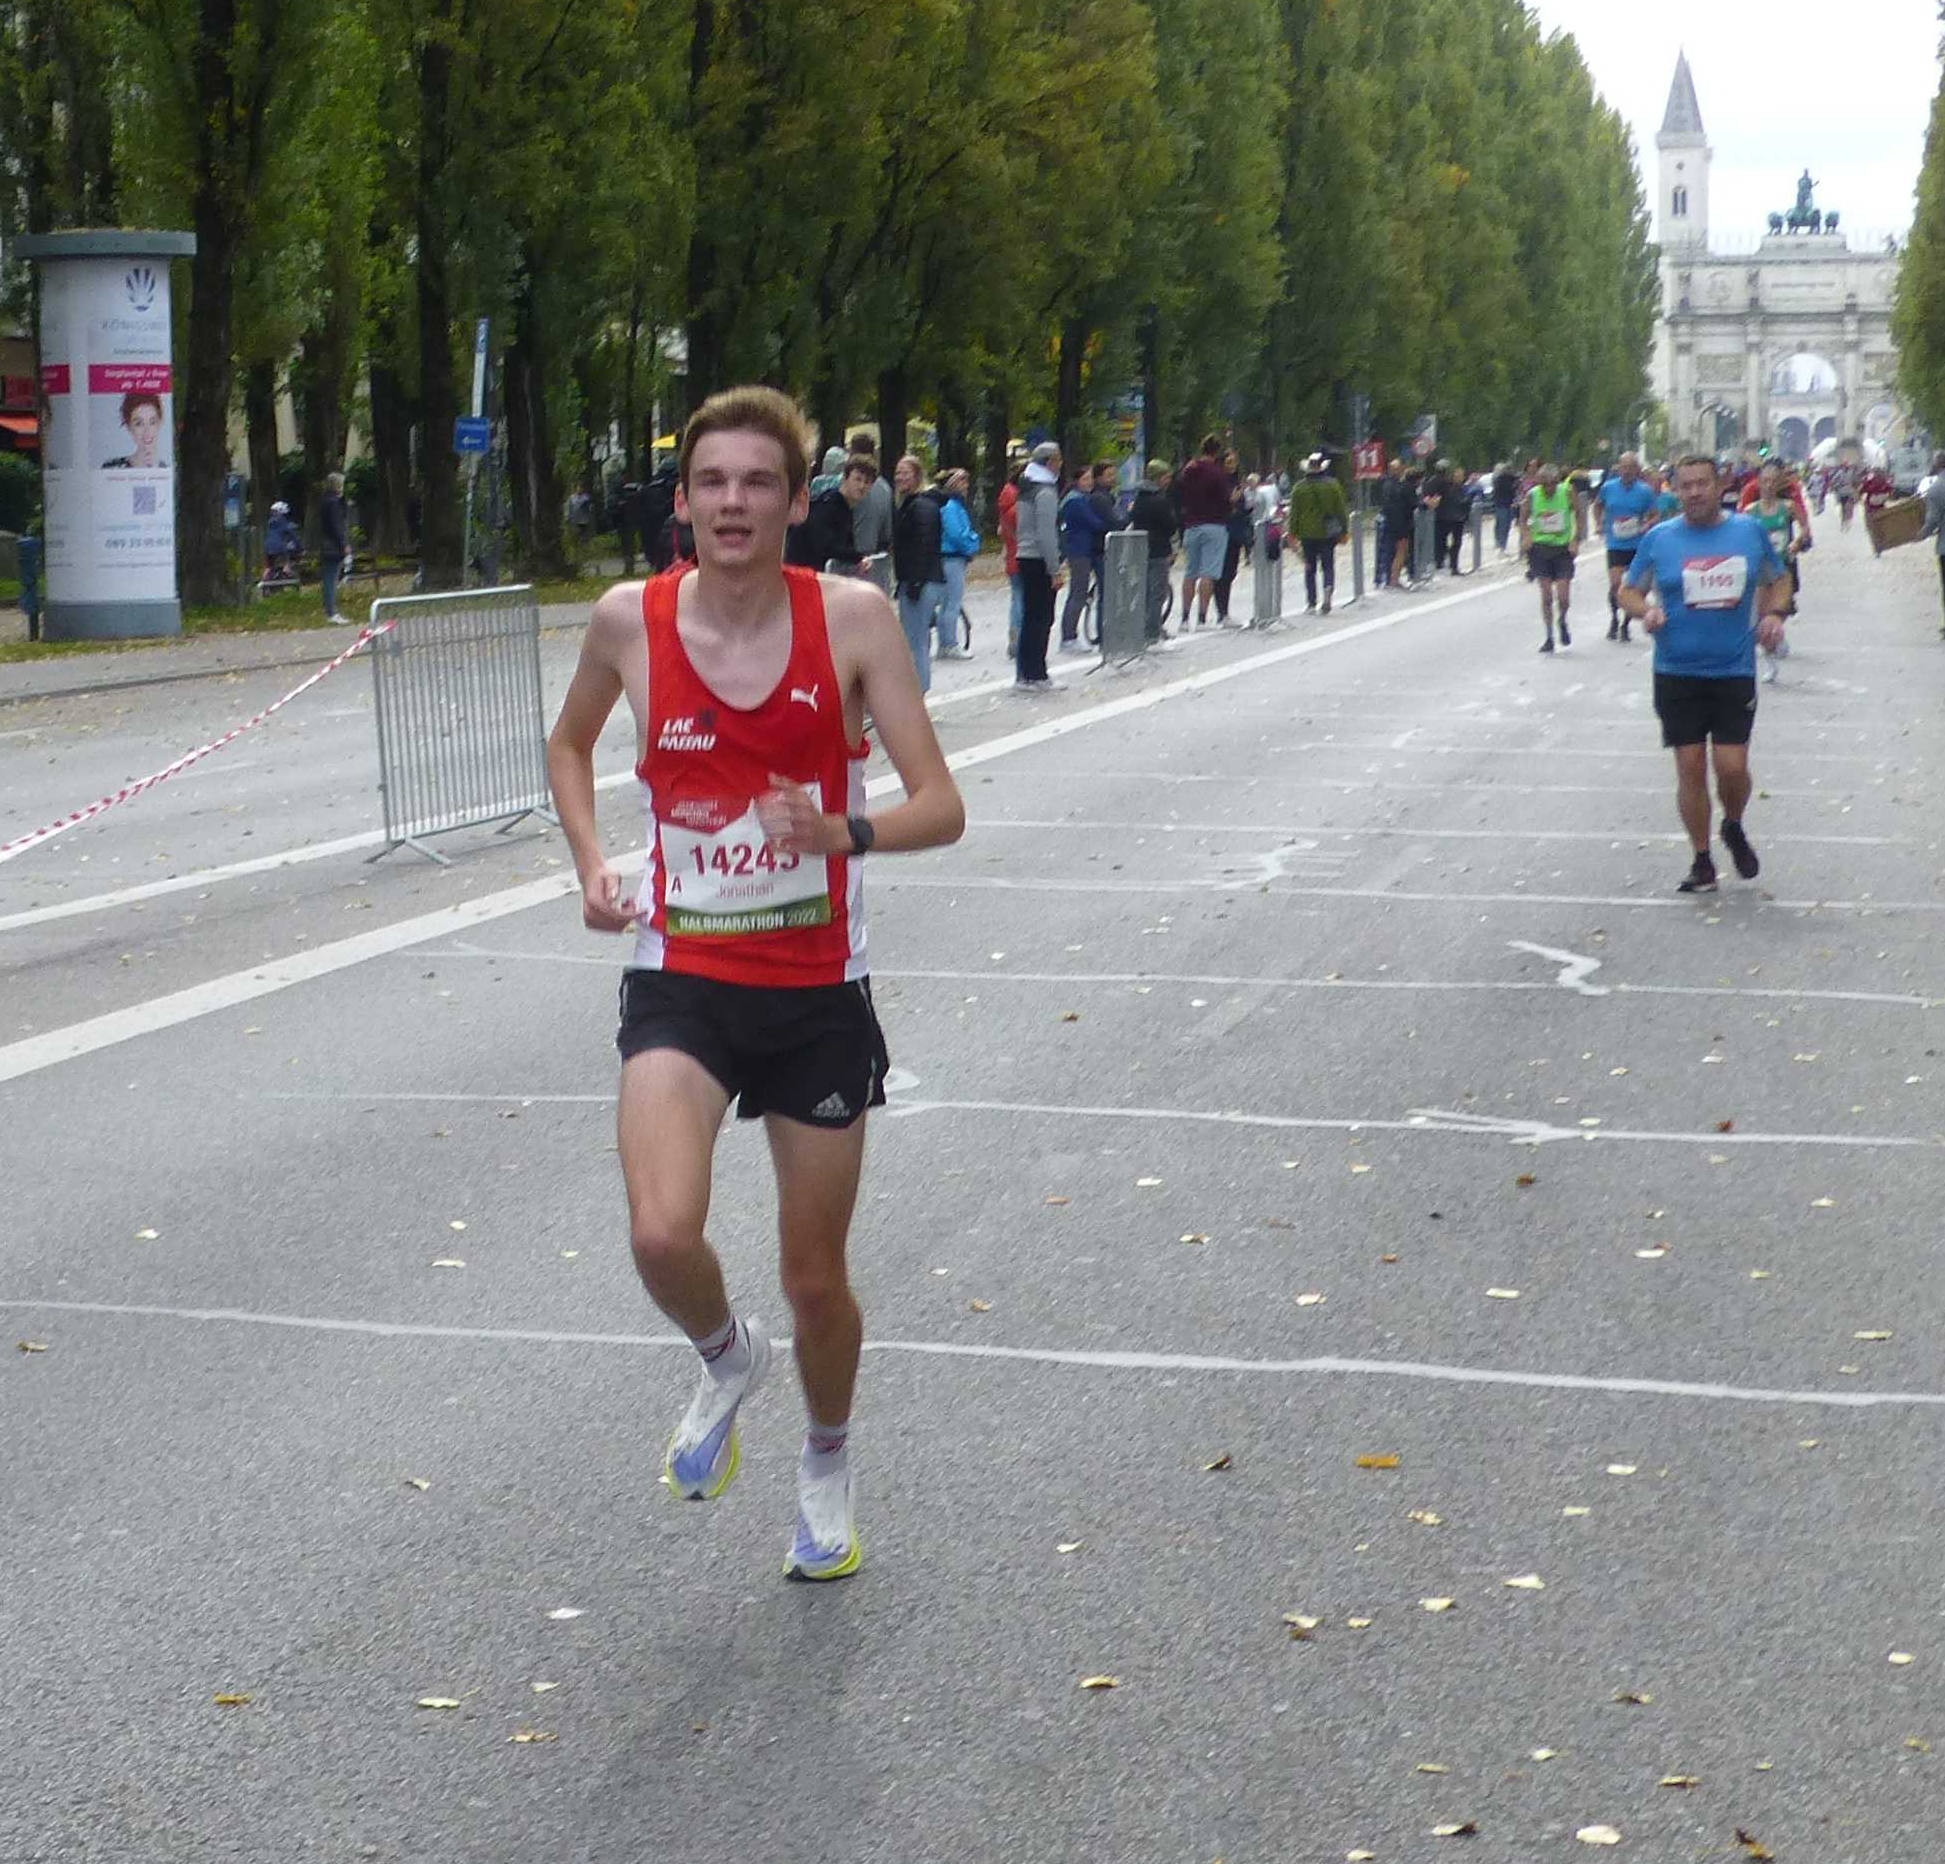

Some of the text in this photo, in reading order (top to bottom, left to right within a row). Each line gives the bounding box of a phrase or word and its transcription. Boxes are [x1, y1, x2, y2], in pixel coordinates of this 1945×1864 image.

[1359, 449, 1379, 468] 11
[658, 734, 717, 751] PASSAU
[671, 875, 682, 893] A
[716, 881, 775, 899] Jonathan
[679, 907, 817, 931] HALBMARATHON 2022
